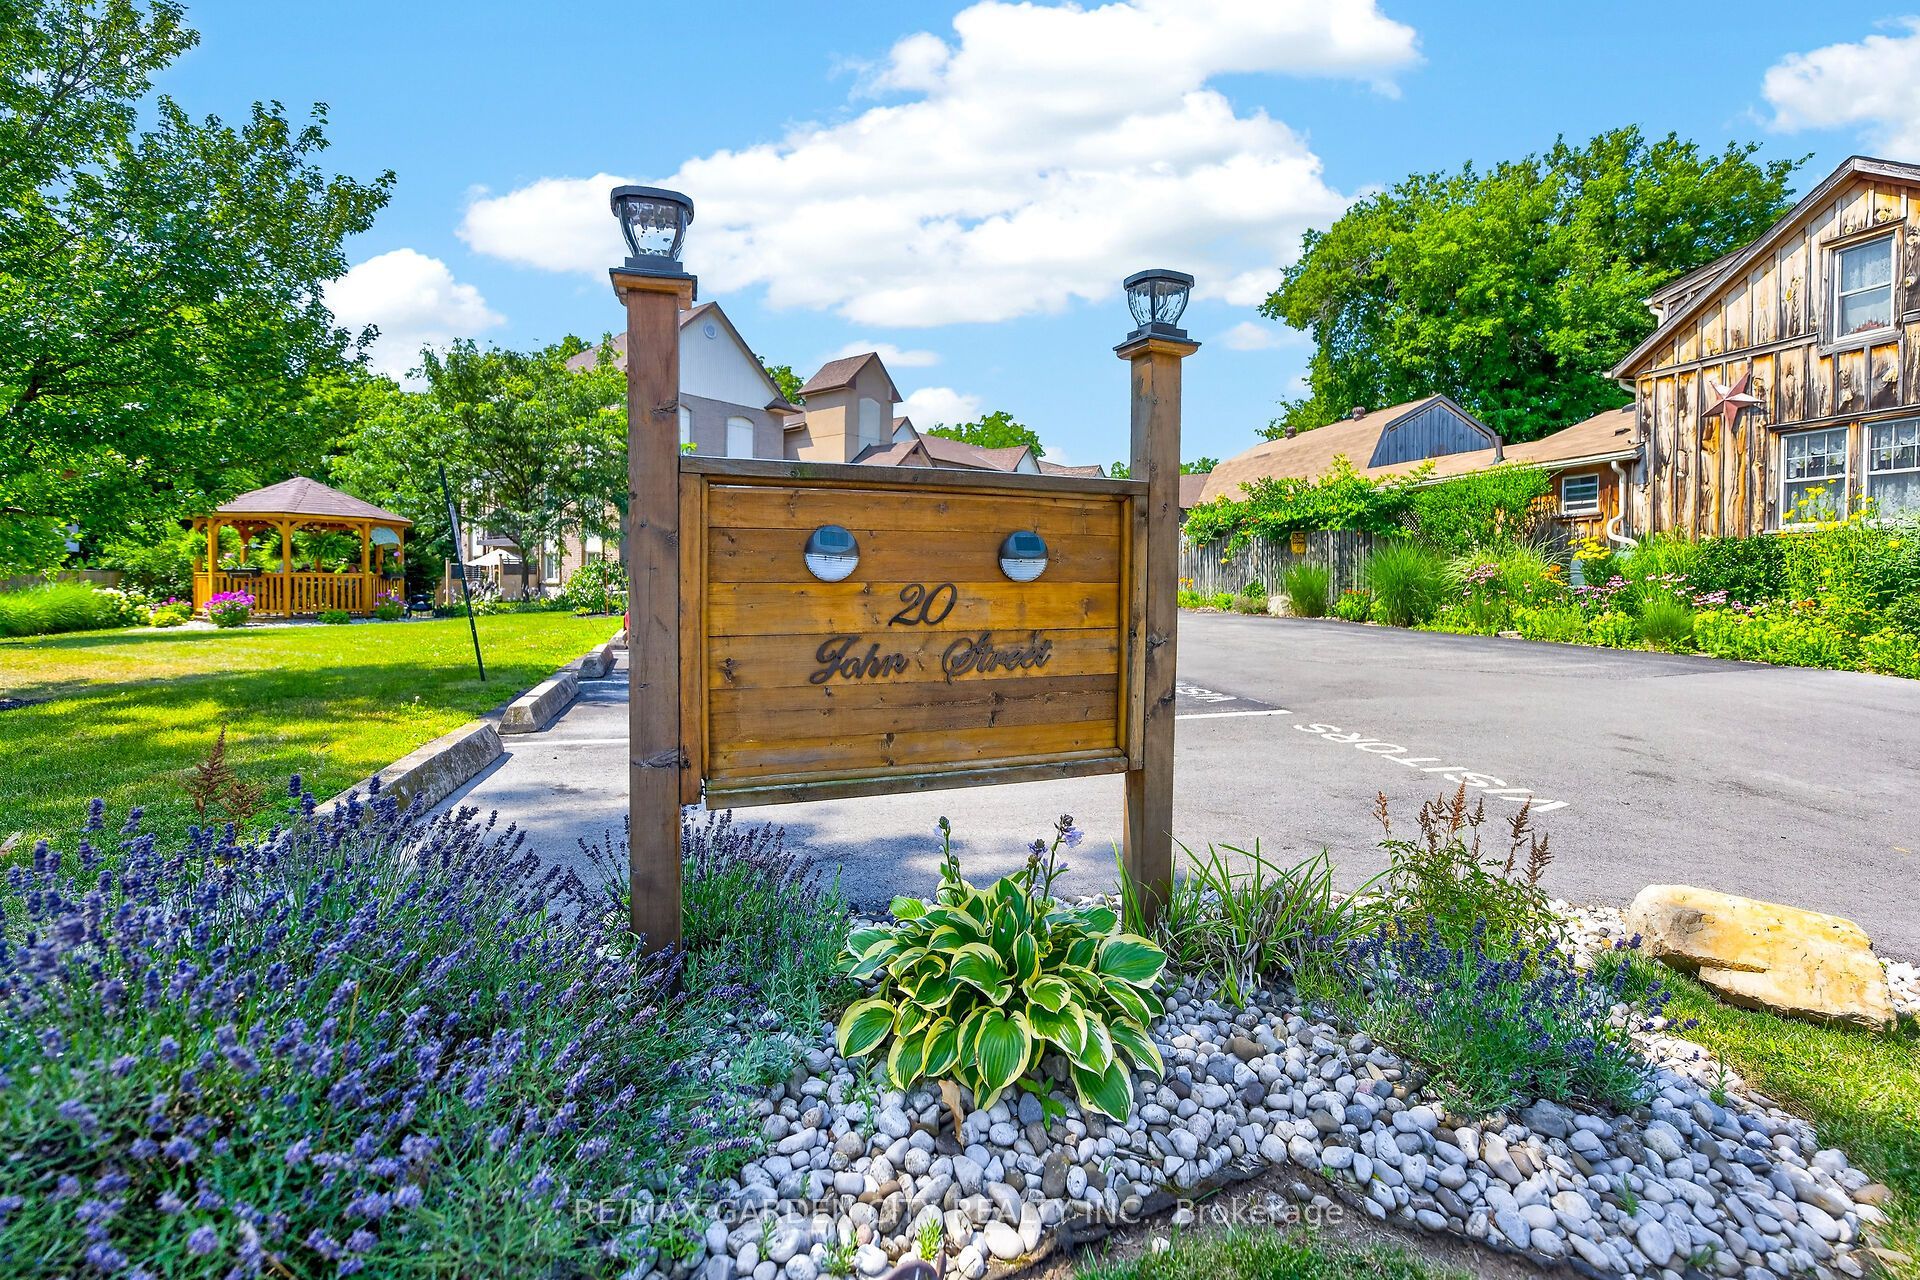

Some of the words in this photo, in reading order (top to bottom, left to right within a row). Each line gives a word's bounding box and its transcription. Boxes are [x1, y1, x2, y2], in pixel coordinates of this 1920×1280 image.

[888, 583, 958, 627] 20
[809, 635, 911, 685] John
[941, 630, 1053, 685] Street
[1293, 723, 1570, 812] VISITORS
